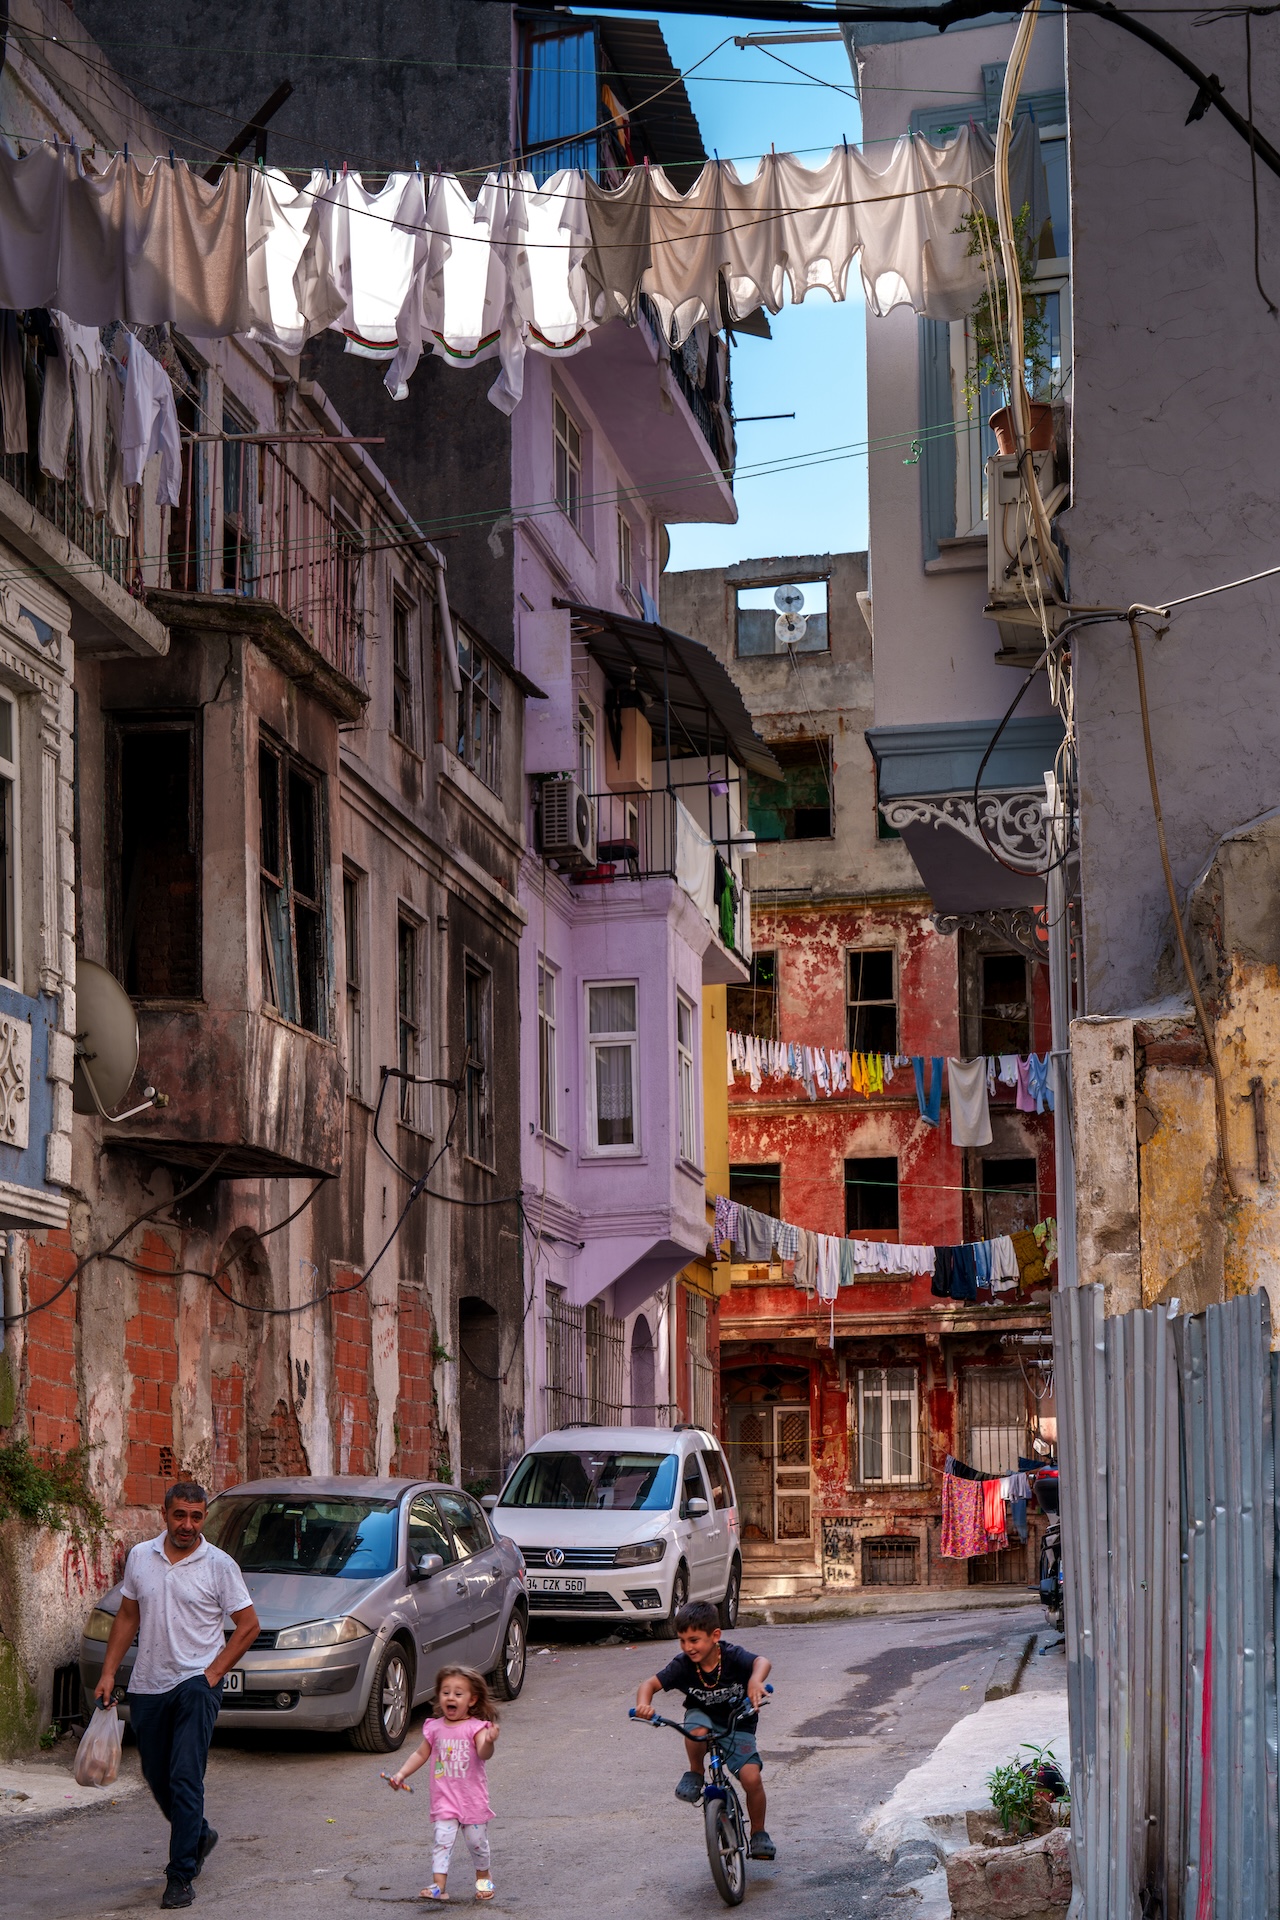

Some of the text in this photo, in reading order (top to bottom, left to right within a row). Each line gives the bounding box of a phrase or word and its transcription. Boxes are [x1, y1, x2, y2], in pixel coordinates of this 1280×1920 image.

[543, 1579, 560, 1591] CZK
[565, 1580, 583, 1591] 560
[436, 1738, 470, 1750] UMMER
[440, 1749, 470, 1762] VBES
[435, 1760, 470, 1779] NLY
